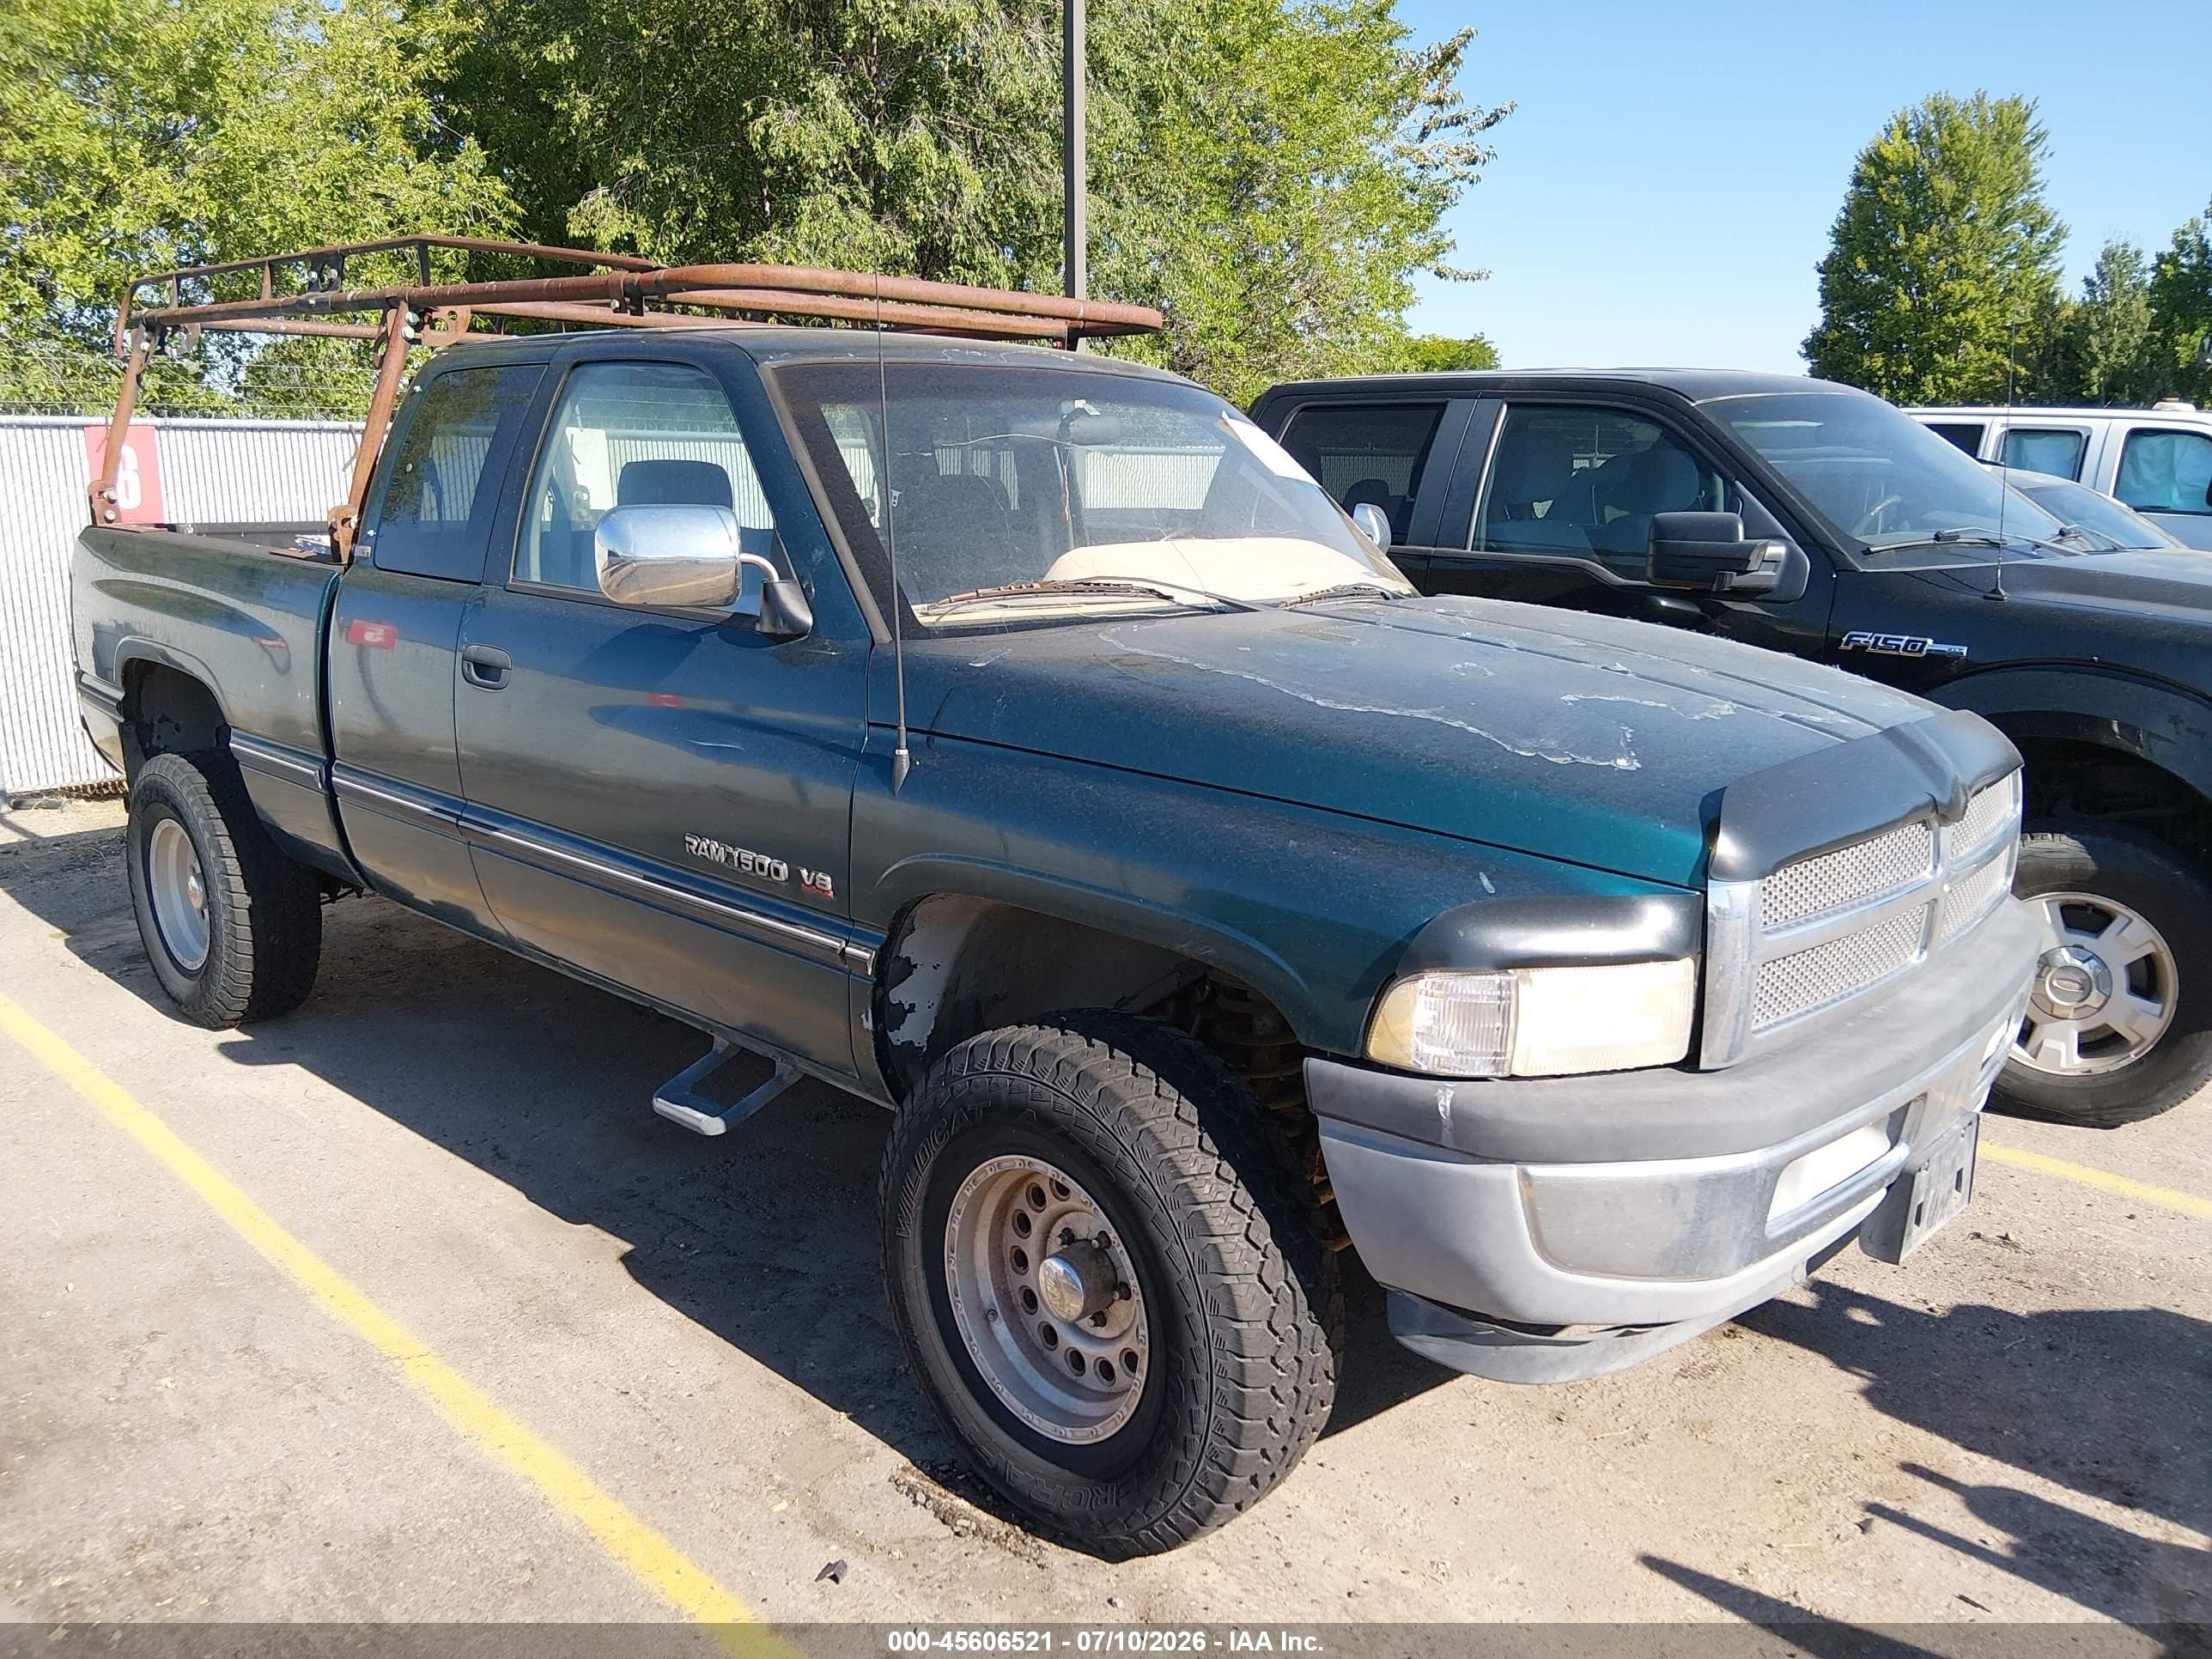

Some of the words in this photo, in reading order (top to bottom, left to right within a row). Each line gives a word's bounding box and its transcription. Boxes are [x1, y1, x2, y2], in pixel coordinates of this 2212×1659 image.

[1838, 630, 1933, 658] F-150
[684, 833, 726, 864] RAM
[726, 844, 789, 882] 1500
[797, 866, 833, 891] V8
[896, 1100, 992, 1237] WILDCAT
